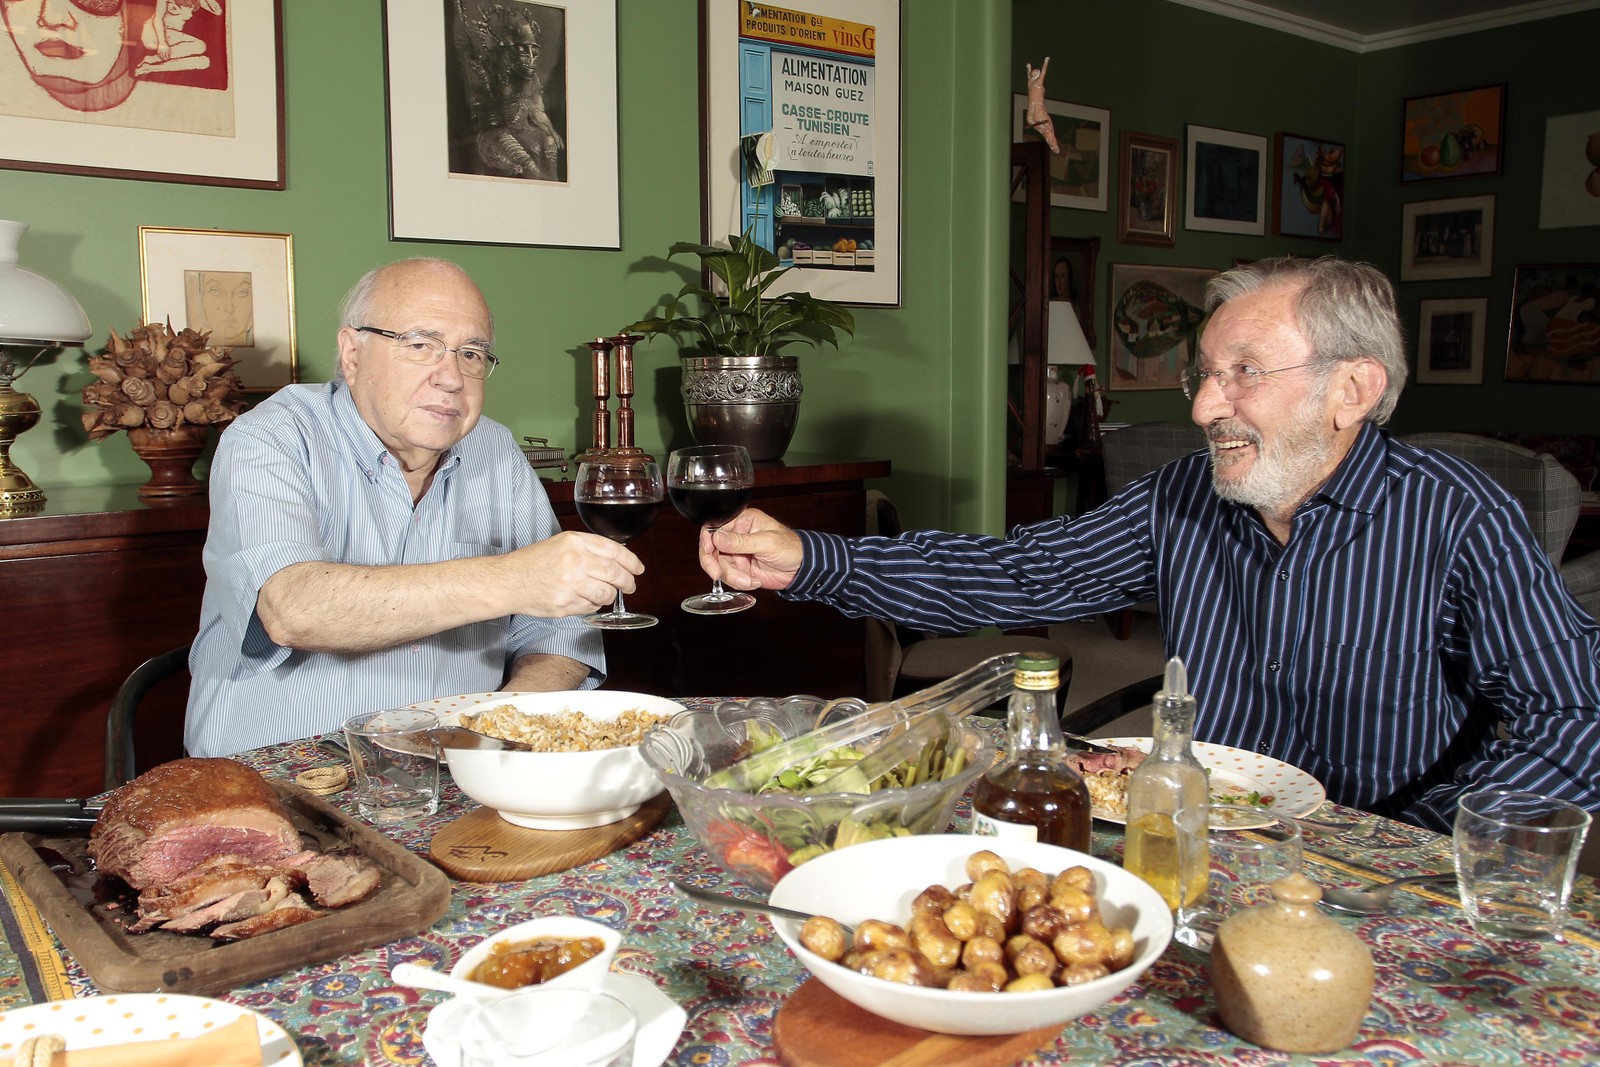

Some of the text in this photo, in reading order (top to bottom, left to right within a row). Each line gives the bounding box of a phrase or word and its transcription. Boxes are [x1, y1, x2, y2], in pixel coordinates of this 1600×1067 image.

[746, 19, 826, 41] PRODUITS D'ORIENT
[782, 57, 867, 86] ALIMENTATION
[784, 80, 864, 102] MAISON GUEZ
[781, 103, 869, 126] CASSE-CROUTE
[797, 118, 849, 136] TUNISIEN
[809, 138, 853, 150] emporter
